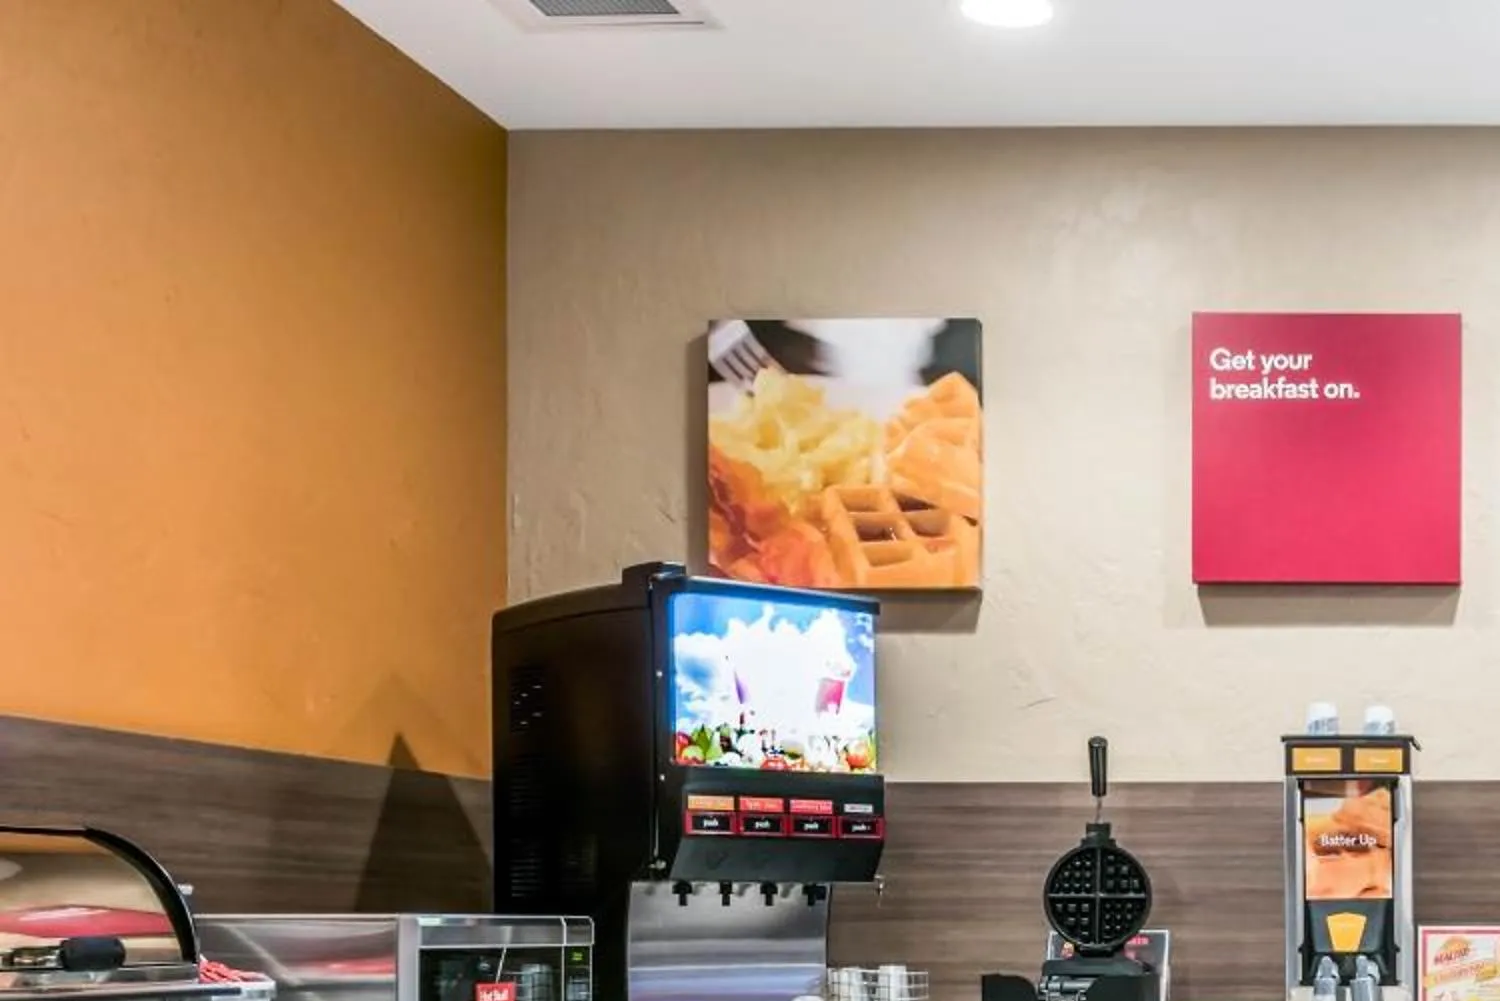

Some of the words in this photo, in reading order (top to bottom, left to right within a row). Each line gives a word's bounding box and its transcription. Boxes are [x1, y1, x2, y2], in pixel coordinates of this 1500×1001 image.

[1209, 347, 1256, 371] Get
[1260, 353, 1312, 375] your
[1209, 376, 1319, 400] breakfast
[1323, 382, 1361, 400] on.
[1321, 833, 1357, 846] Batter
[1359, 833, 1377, 848] Up
